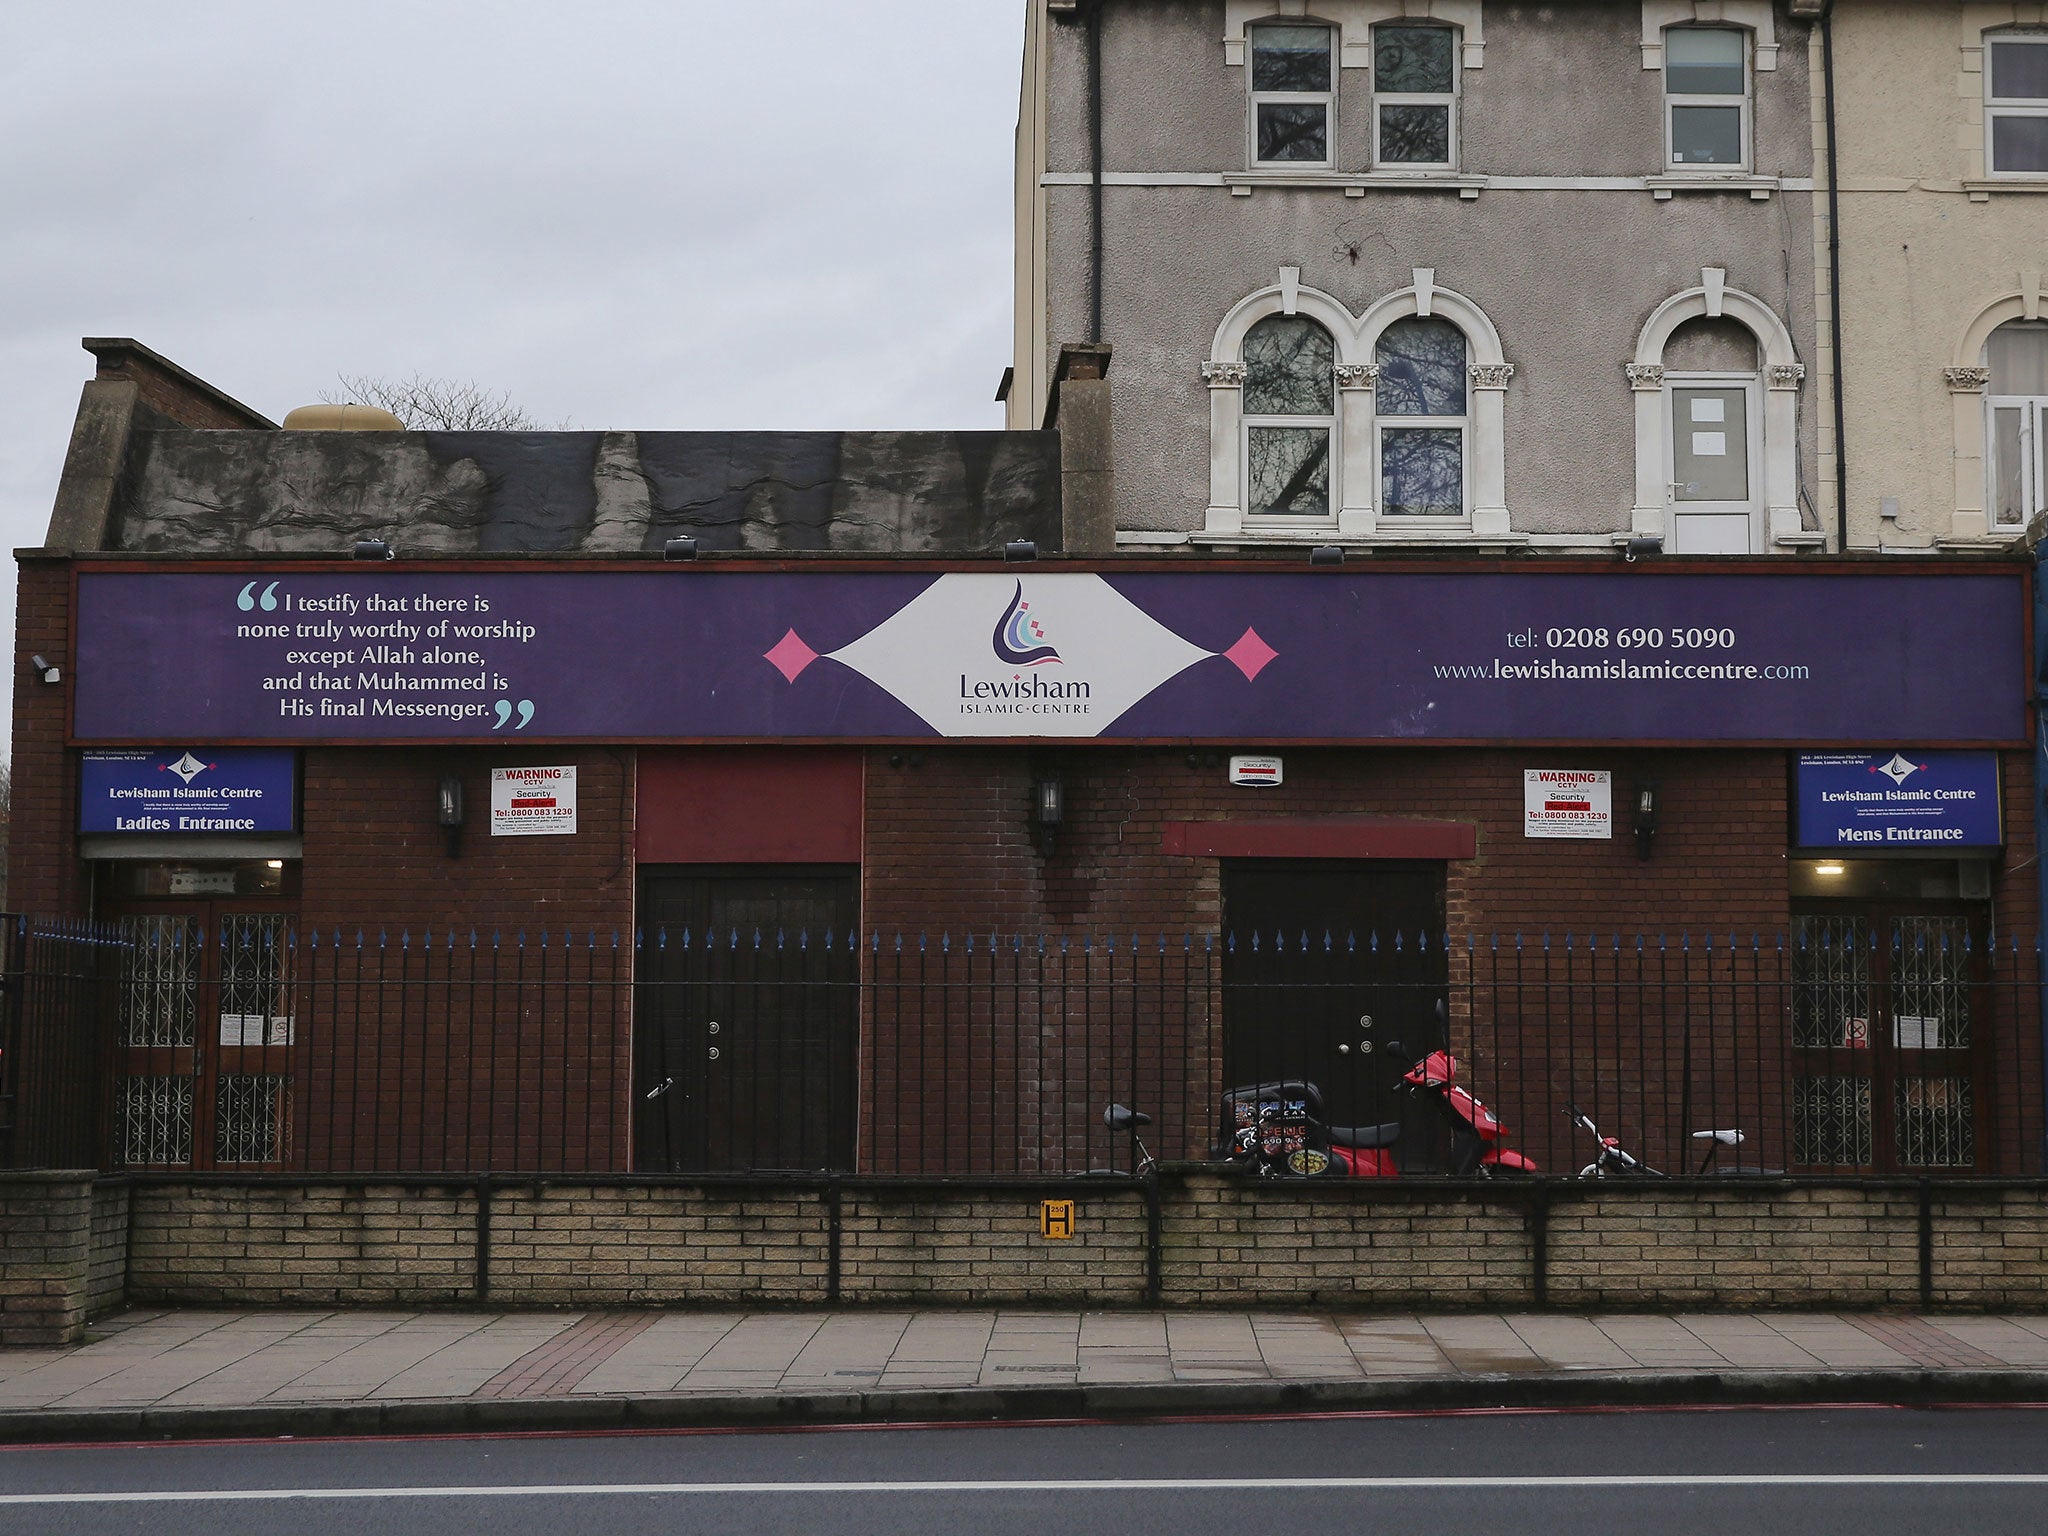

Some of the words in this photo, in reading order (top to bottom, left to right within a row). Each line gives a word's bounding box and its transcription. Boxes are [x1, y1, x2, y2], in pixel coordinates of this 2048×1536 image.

[298, 594, 360, 616] testify
[365, 594, 409, 611] that
[413, 594, 468, 611] there
[474, 594, 490, 611] is
[237, 625, 290, 638] none
[296, 620, 344, 642] truly
[348, 620, 421, 642] worthy
[426, 620, 449, 638] of
[453, 620, 536, 642] worship
[1507, 628, 1538, 648] tel:
[1546, 628, 1609, 648] 0208
[1616, 628, 1664, 649] 690
[1671, 628, 1735, 649] 5090
[286, 649, 356, 669] except
[359, 646, 415, 664] Allah
[421, 646, 486, 667] alone,
[1433, 659, 1810, 680] www.lewishamislamiccentre.com
[262, 672, 302, 690] and
[309, 672, 352, 690] that
[357, 672, 486, 690] Muhammed
[493, 672, 509, 690] is
[960, 673, 1090, 699] Lewisham
[280, 699, 314, 717] His
[319, 698, 365, 716] final
[960, 703, 1026, 714] ISLAMIC
[1032, 703, 1090, 714] CENTRE
[506, 768, 562, 780] WARNING
[1539, 772, 1596, 783] WARNING
[110, 787, 170, 799] Lewisham
[173, 787, 218, 798] Islamic
[220, 787, 263, 798] Centre
[516, 790, 551, 799] Security
[1550, 793, 1585, 802] Security
[1822, 790, 1883, 802] Lewisham
[1886, 789, 1931, 801] Islamic
[1933, 789, 1976, 800] Centre
[511, 809, 533, 817] 0800
[534, 808, 551, 816] 083
[553, 807, 573, 816] 1230
[1544, 811, 1567, 819] 0800
[1587, 812, 1608, 820] 1230
[116, 815, 171, 830] Ladies
[179, 816, 255, 830] Entrance
[1838, 828, 1883, 842] Mens
[1886, 827, 1964, 841] Entrance
[1046, 1204, 1069, 1235] H
